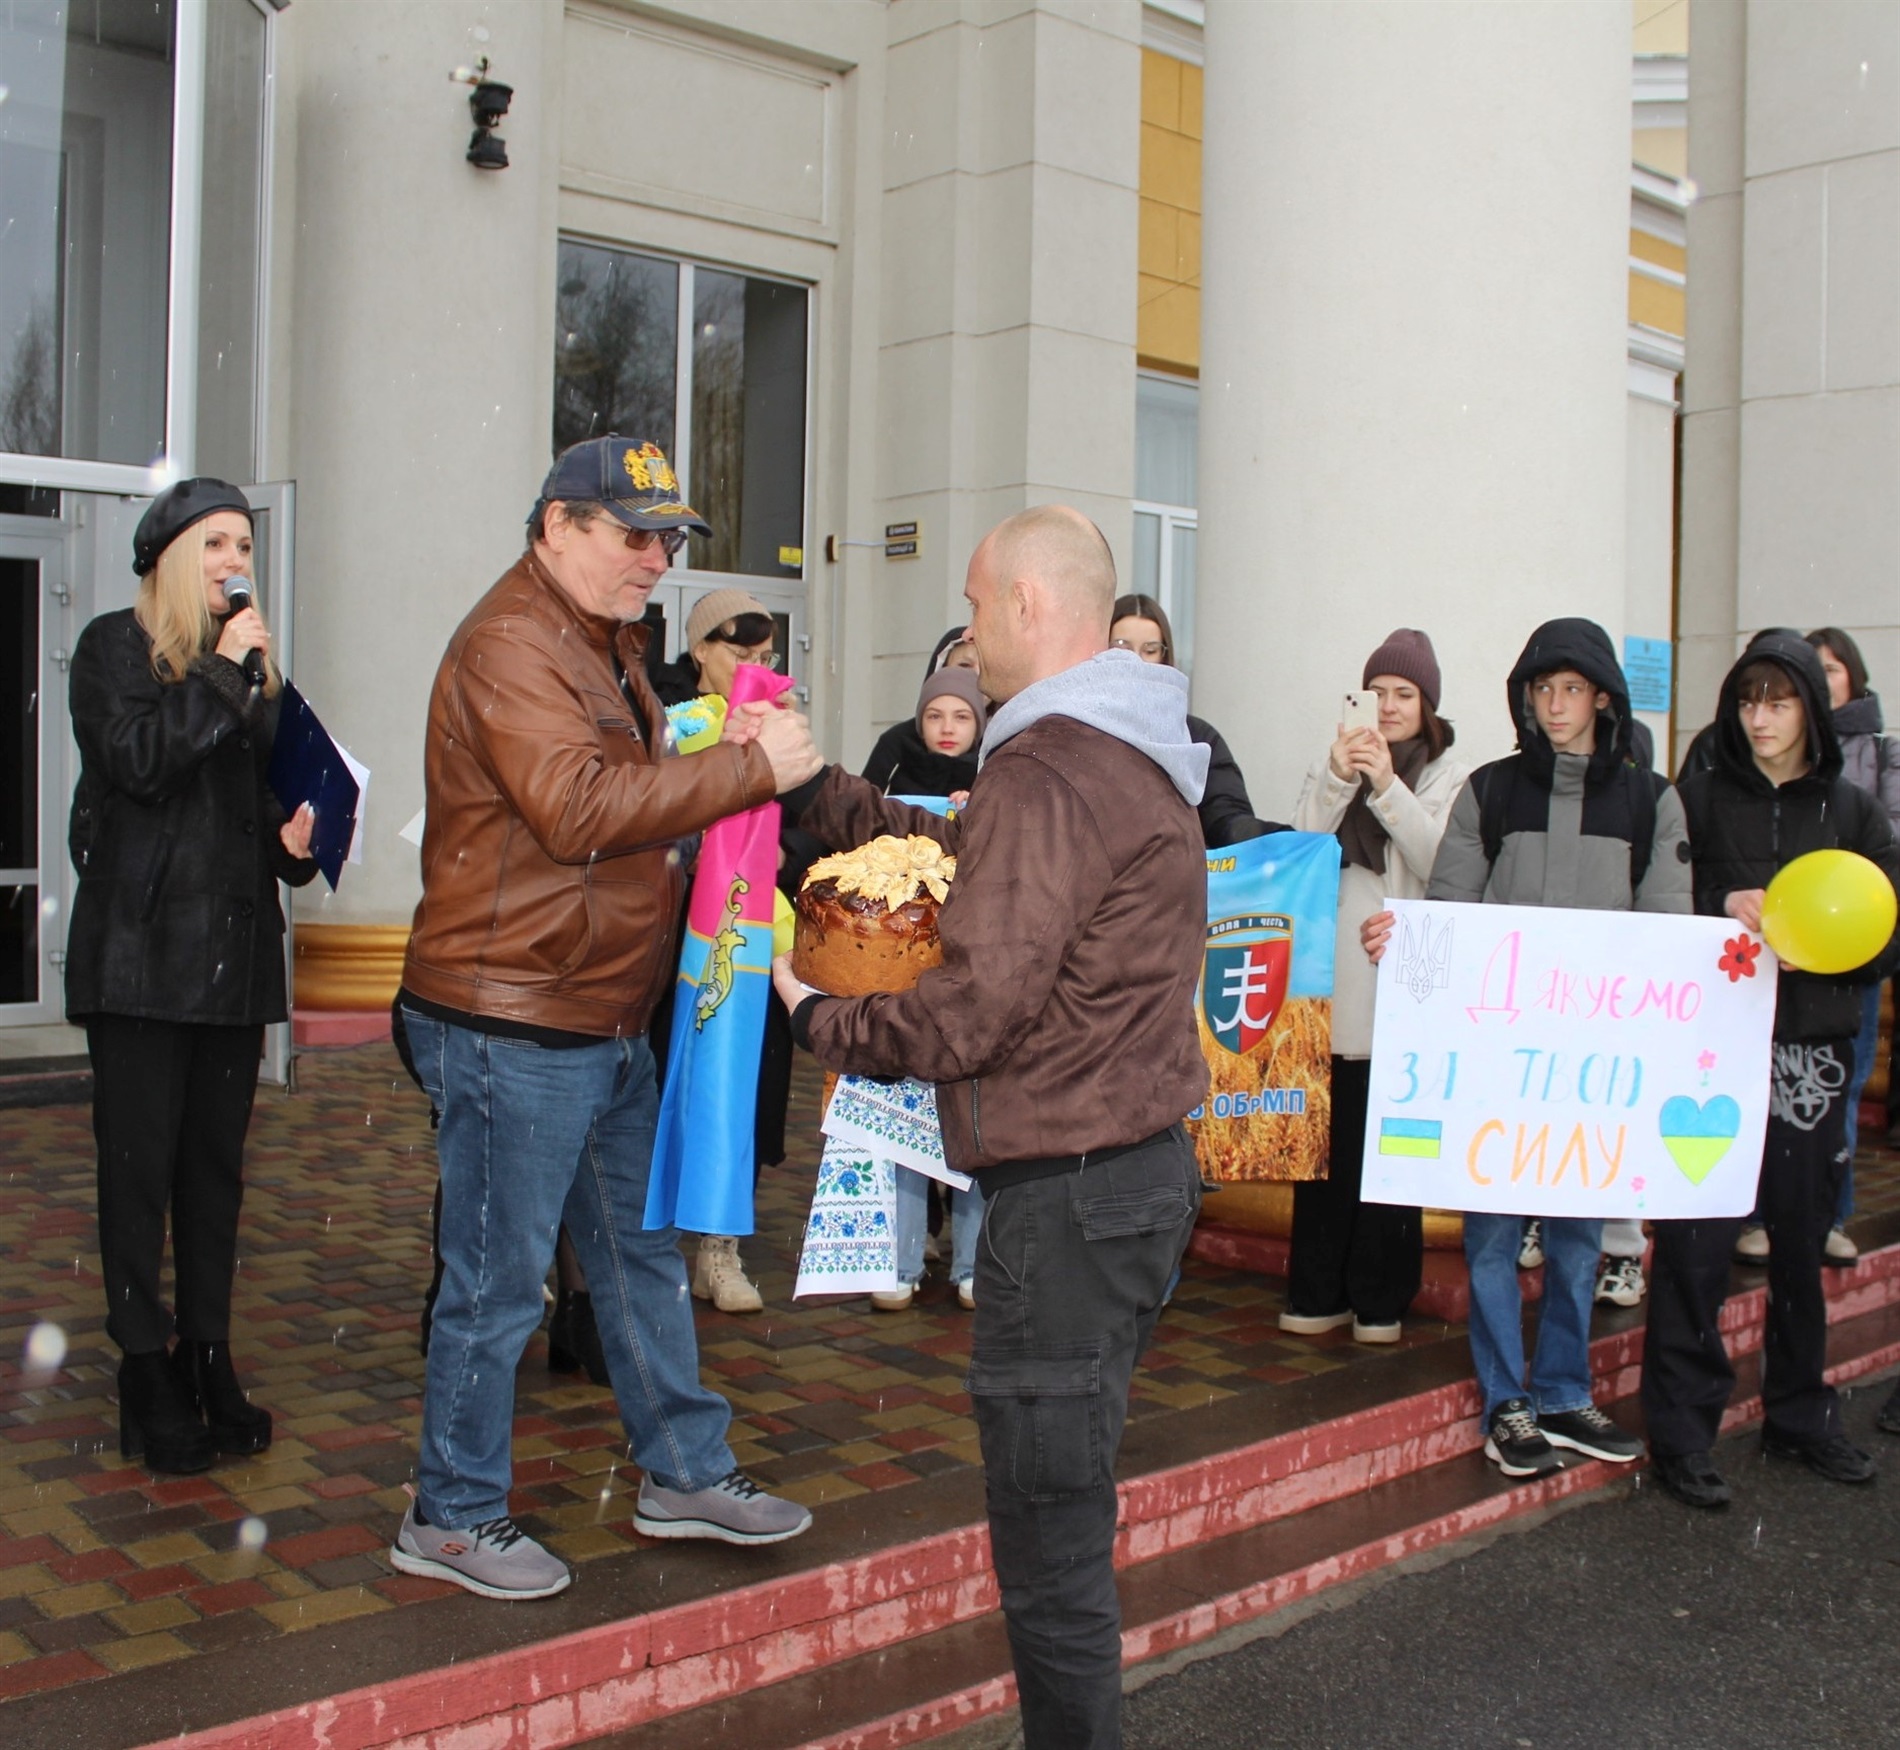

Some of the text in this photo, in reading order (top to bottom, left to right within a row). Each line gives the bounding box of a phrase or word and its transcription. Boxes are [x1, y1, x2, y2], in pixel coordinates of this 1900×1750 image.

[1211, 919, 1240, 936] ВОЛЯ
[1260, 917, 1284, 928] ЧЕСТЬ
[1466, 1118, 1627, 1190] СИЛУ
